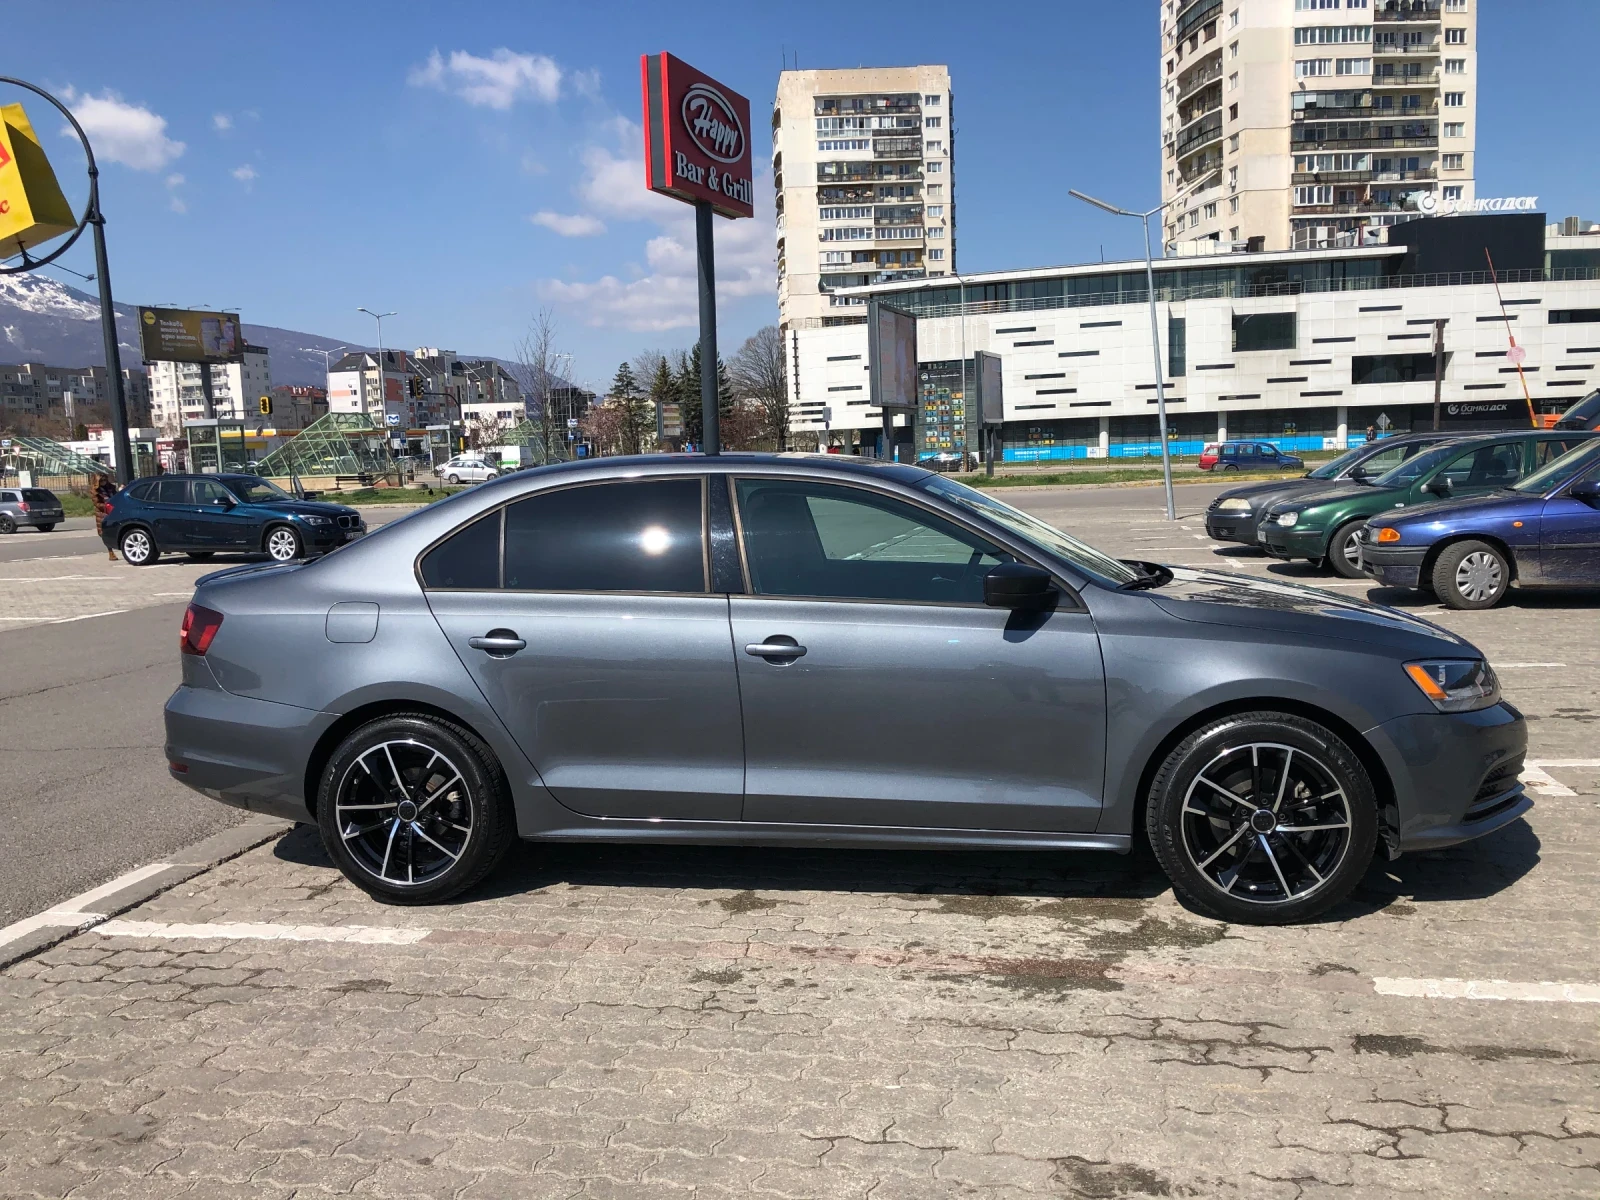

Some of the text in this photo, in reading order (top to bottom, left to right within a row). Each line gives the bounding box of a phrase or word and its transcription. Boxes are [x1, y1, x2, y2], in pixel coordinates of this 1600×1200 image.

[690, 97, 738, 157] Happy
[675, 150, 753, 206] Bar & Grill
[1460, 404, 1489, 412] банка
